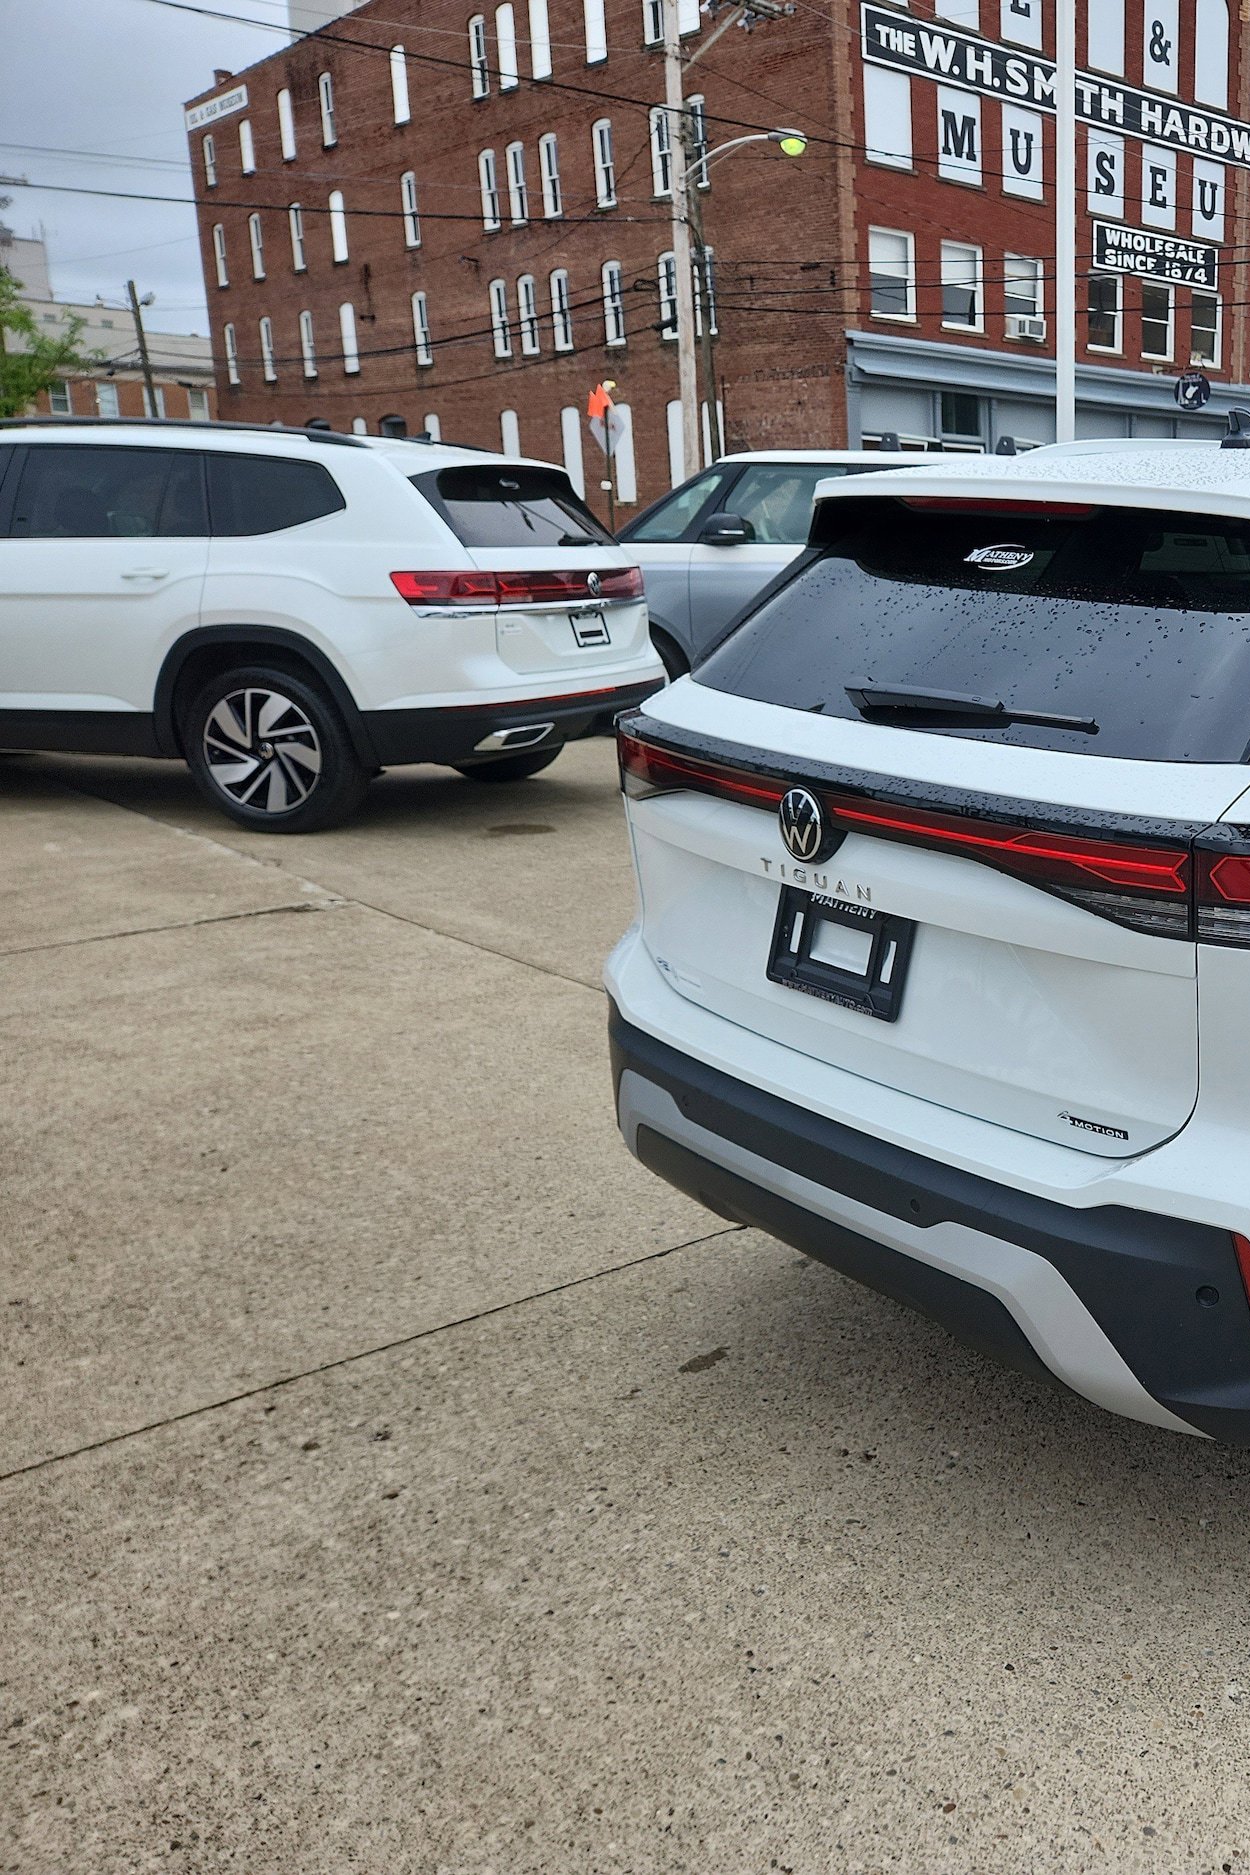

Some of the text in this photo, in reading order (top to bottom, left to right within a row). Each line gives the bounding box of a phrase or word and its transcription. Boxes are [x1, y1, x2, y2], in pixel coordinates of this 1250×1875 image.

[875, 24, 917, 58] THE
[1149, 20, 1172, 66] &
[1105, 228, 1206, 265] WHOLESALE
[1104, 249, 1208, 284] SINCE 1874
[963, 549, 1032, 562] MATHENY
[760, 857, 872, 901] TIGUAN
